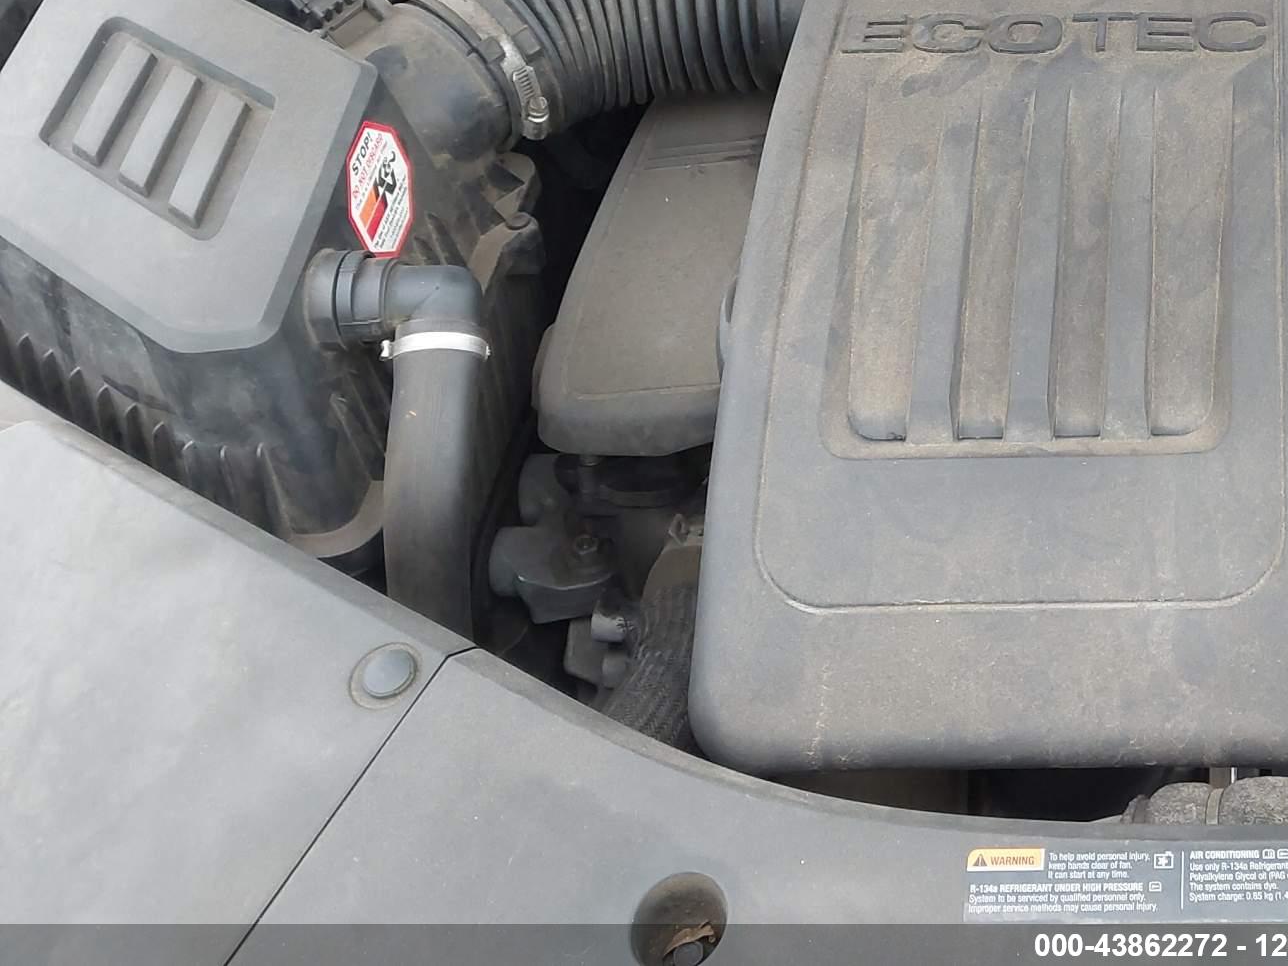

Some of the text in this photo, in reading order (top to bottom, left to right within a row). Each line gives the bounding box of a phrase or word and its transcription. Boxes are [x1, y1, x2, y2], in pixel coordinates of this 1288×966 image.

[839, 11, 1268, 55] ECOTEC
[352, 131, 373, 176] STOP!
[1060, 853, 1074, 861] help
[1097, 852, 1128, 861] personal
[1190, 850, 1259, 859] AIR CONDITIONING
[990, 856, 1034, 866] WARNING
[1049, 862, 1066, 870] keep
[1068, 861, 1089, 869] hands
[1190, 863, 1203, 871] Use
[1205, 863, 1219, 872] only
[1250, 862, 1288, 871] Refrigerant
[1096, 872, 1109, 880] any
[1235, 872, 1256, 880] Glycol
[1269, 872, 1285, 880] (PAG
[1000, 884, 1052, 892] REFRIGERANT
[1083, 883, 1101, 891] HIGH
[1104, 883, 1143, 891] PRESSURE
[1205, 883, 1230, 891] system
[1232, 882, 1262, 890] contains
[969, 894, 996, 904] System
[1007, 894, 1016, 902] be
[1018, 894, 1047, 902] serviced
[1050, 894, 1058, 903] by
[1061, 893, 1090, 903] qualified
[1093, 893, 1127, 902] personnel
[1190, 893, 1216, 902] System
[1264, 892, 1273, 901] kg
[969, 905, 1000, 914] Improper
[1031, 904, 1061, 912] methods
[1064, 905, 1078, 913] may
[1104, 903, 1134, 912] personal
